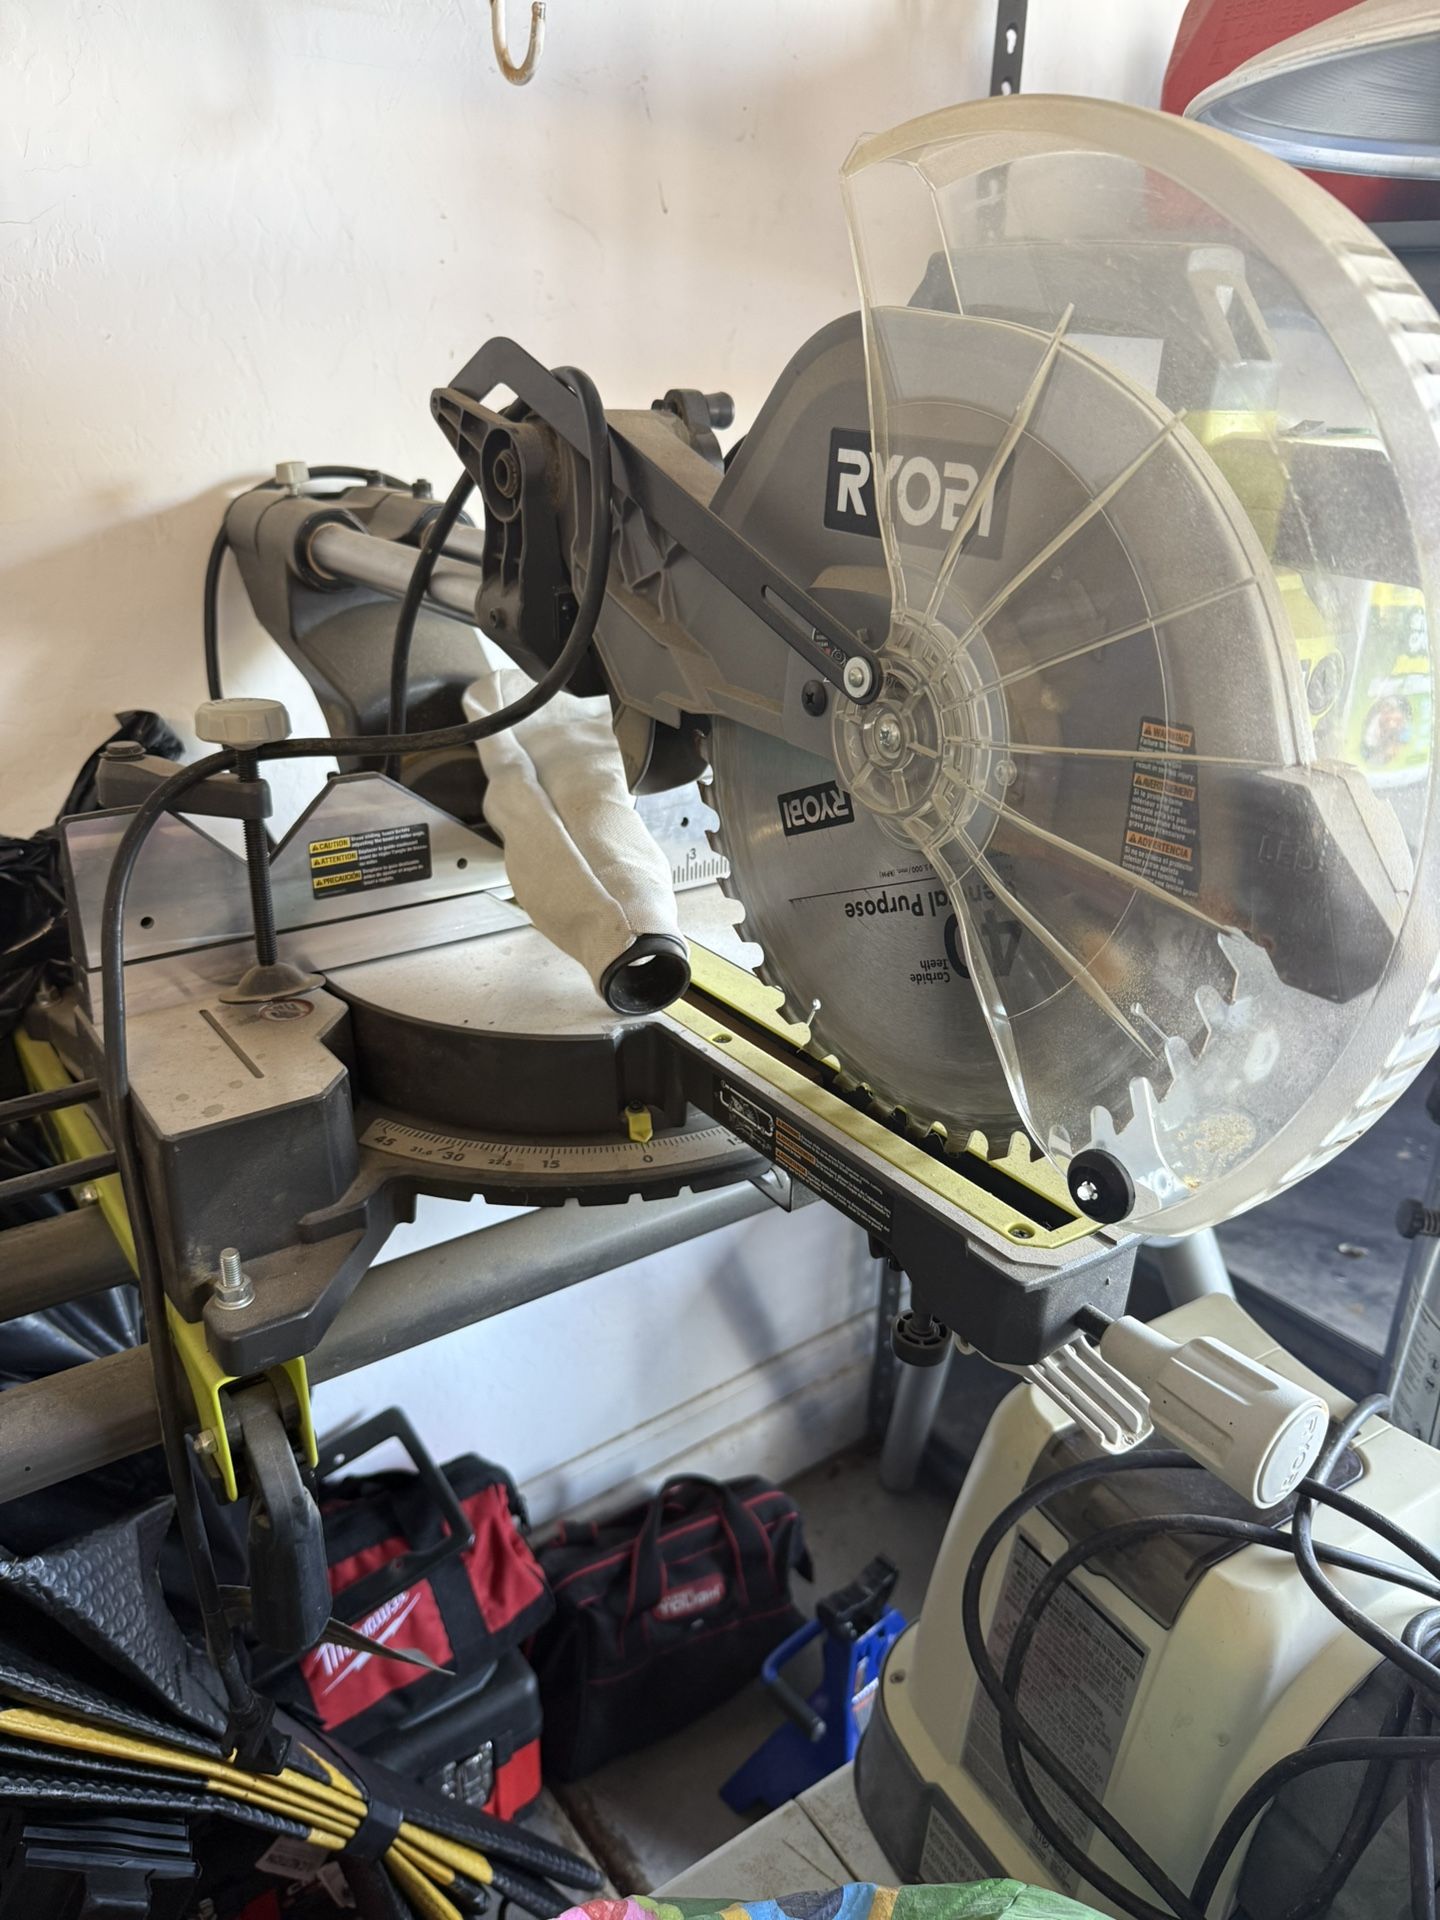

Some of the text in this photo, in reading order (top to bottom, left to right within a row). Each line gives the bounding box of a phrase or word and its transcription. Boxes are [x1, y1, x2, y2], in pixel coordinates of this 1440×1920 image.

[837, 447, 995, 538] RYOBI
[1142, 776, 1195, 800] AVERTEMENT
[783, 790, 850, 829] RYOBI
[319, 839, 349, 850] CAUTION
[690, 848, 698, 859] 3
[321, 852, 357, 865] ATTENTION
[845, 891, 924, 918] Purpose
[920, 958, 950, 972] Teeth
[910, 971, 951, 985] Carbide
[373, 1135, 397, 1147] 45
[442, 1151, 466, 1162] 30
[542, 1159, 560, 1169] 15
[642, 1154, 654, 1164] 0
[1274, 1415, 1319, 1498] RYOBI
[313, 1590, 410, 1677] Miaukee
